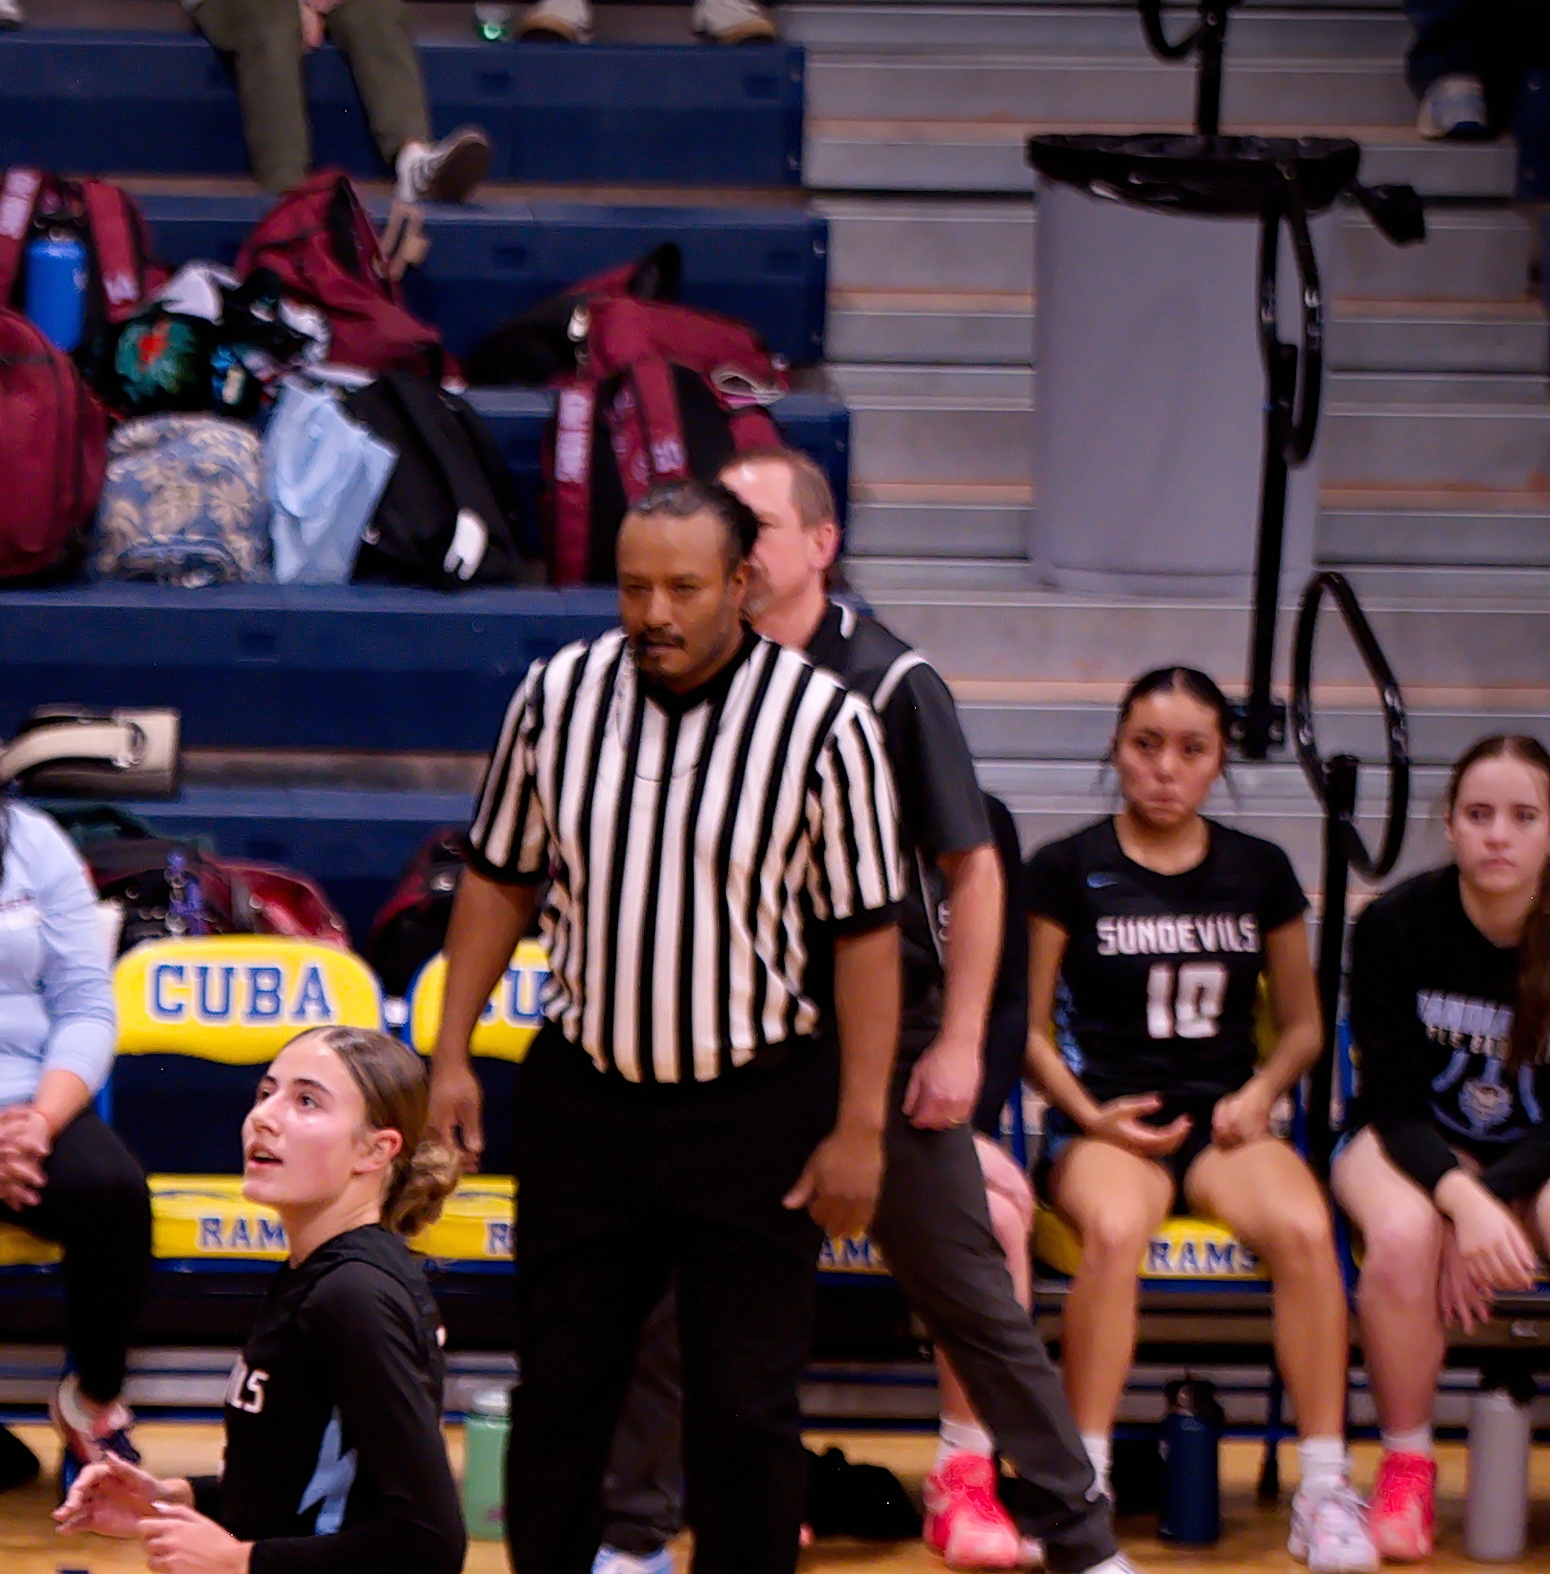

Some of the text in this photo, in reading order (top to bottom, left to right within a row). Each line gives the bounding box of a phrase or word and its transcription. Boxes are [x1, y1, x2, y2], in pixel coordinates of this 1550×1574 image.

[1096, 914, 1261, 956] SUNDEVILS
[150, 962, 334, 1021] CUBA
[1147, 962, 1229, 1039] 10
[199, 1216, 287, 1250] RAM
[1147, 1240, 1260, 1273] RAMS
